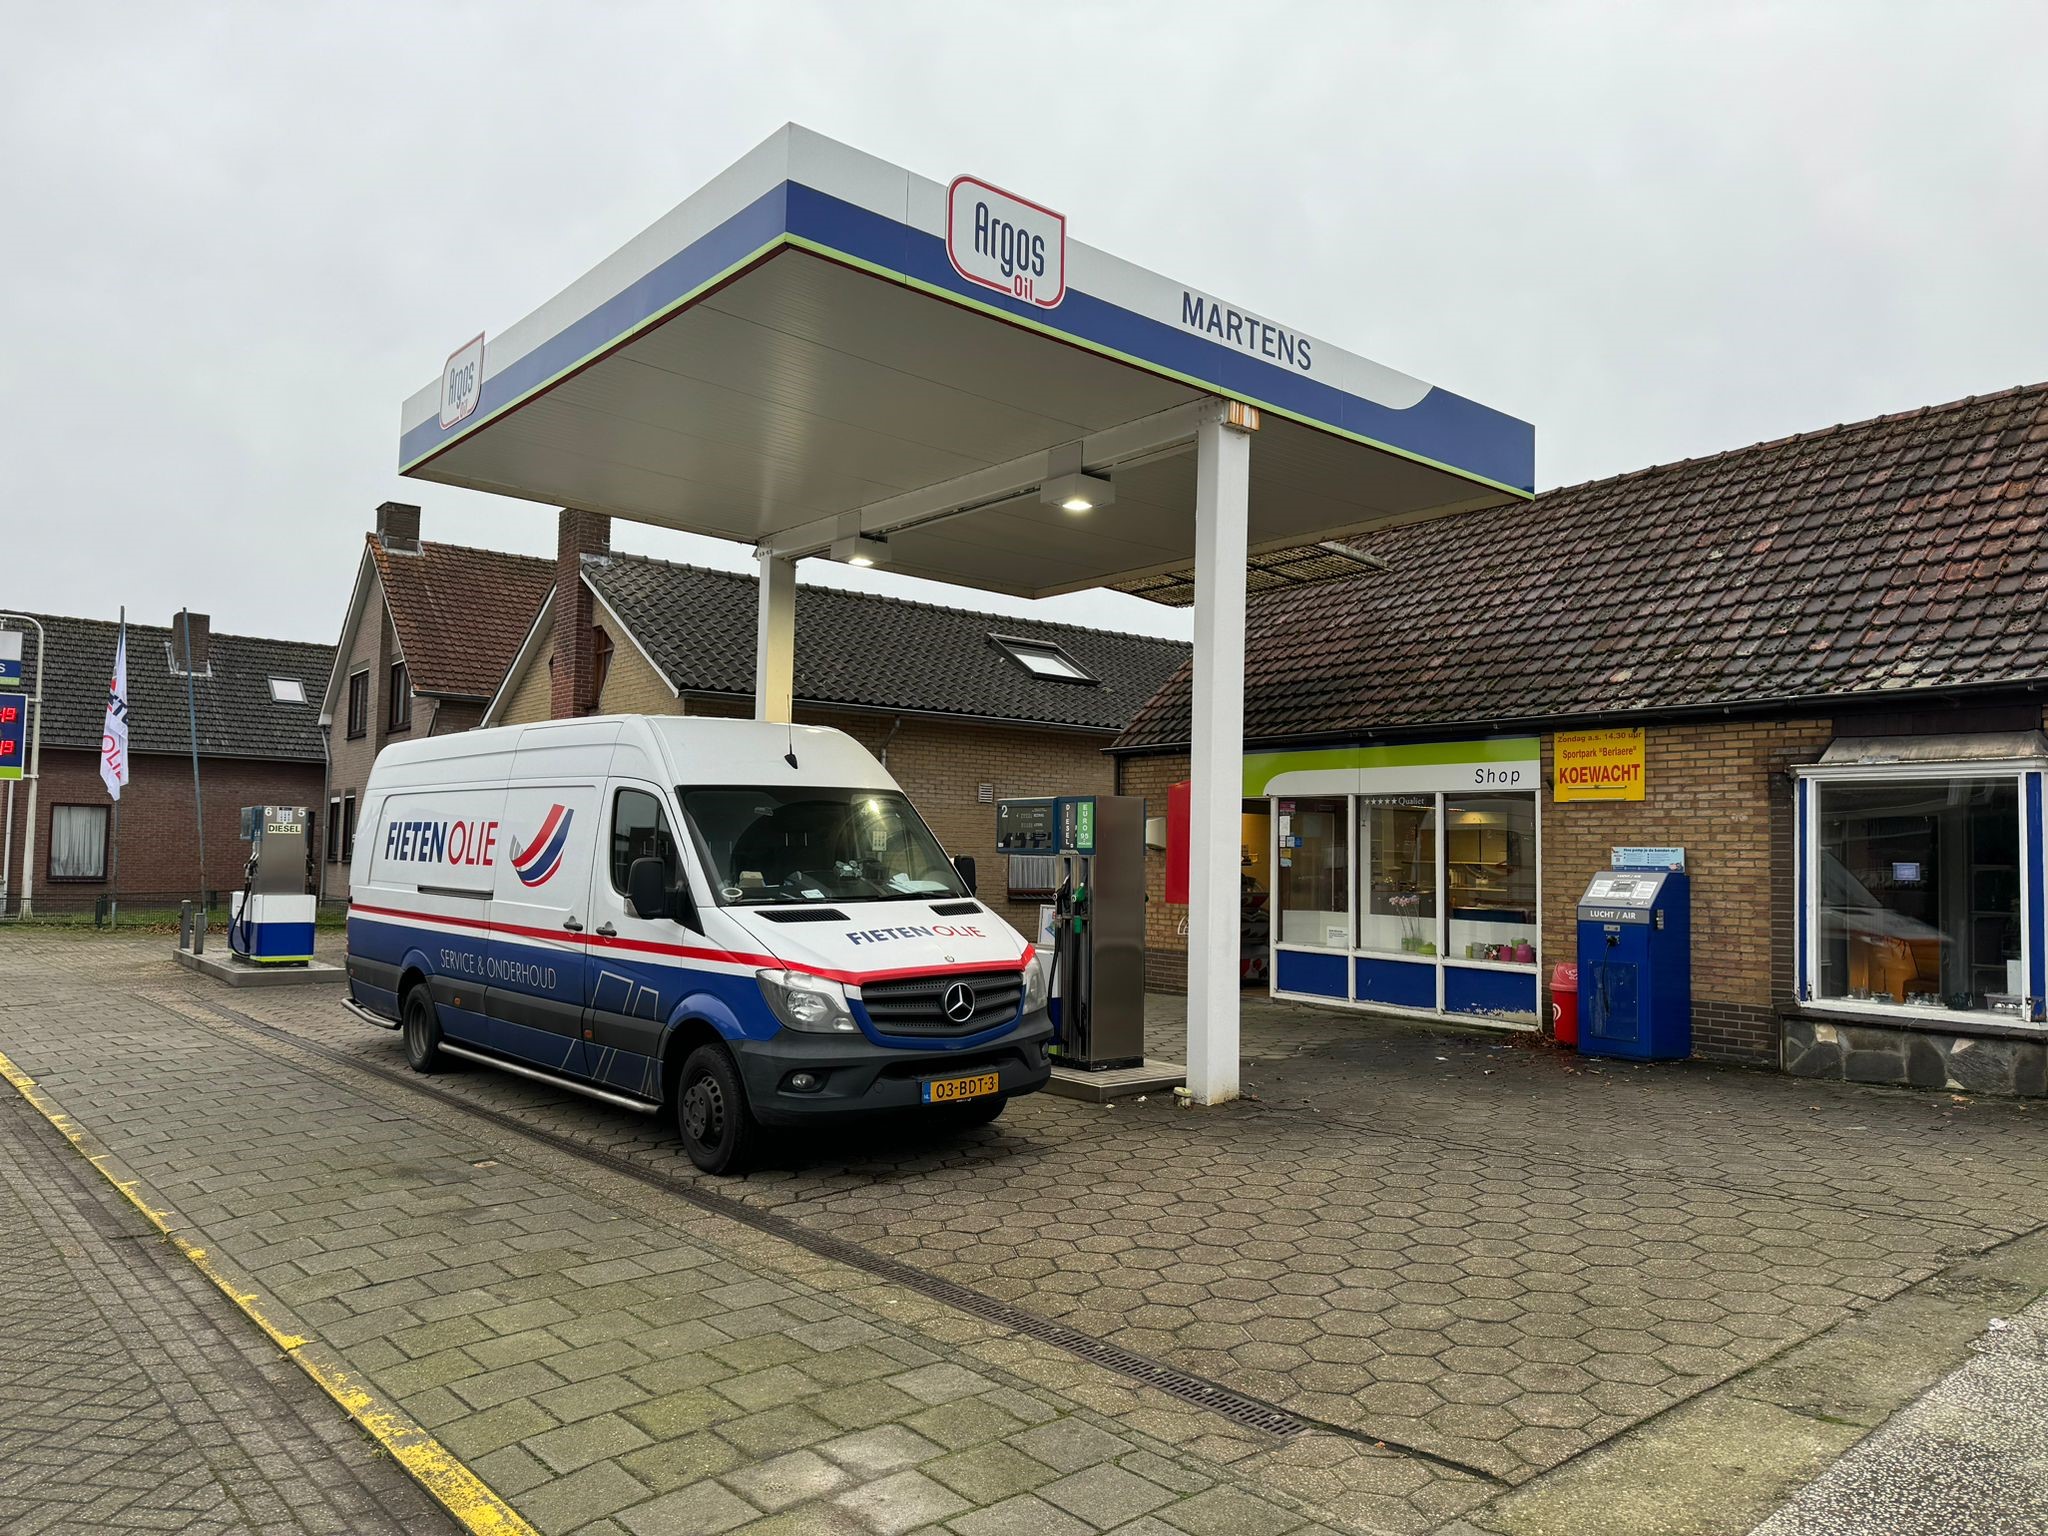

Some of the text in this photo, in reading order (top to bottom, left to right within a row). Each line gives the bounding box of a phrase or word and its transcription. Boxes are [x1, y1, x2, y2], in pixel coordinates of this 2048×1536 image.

[974, 201, 1045, 278] Argos
[1014, 273, 1034, 302] Oil
[1181, 291, 1311, 370] MARTENS
[448, 361, 474, 410] Argos
[1558, 735, 1586, 743] Zondag
[1562, 748, 1597, 760] Sportpark
[1475, 768, 1520, 785] Shop
[1560, 763, 1640, 784] KOEWACHT
[264, 807, 273, 816] 6
[297, 808, 306, 817] 5
[1001, 804, 1009, 818] 2
[1590, 910, 1614, 918] LUCHT
[440, 948, 556, 989] SERVICE & ONDERHOUD
[936, 1076, 994, 1098] 03-BDT-3
